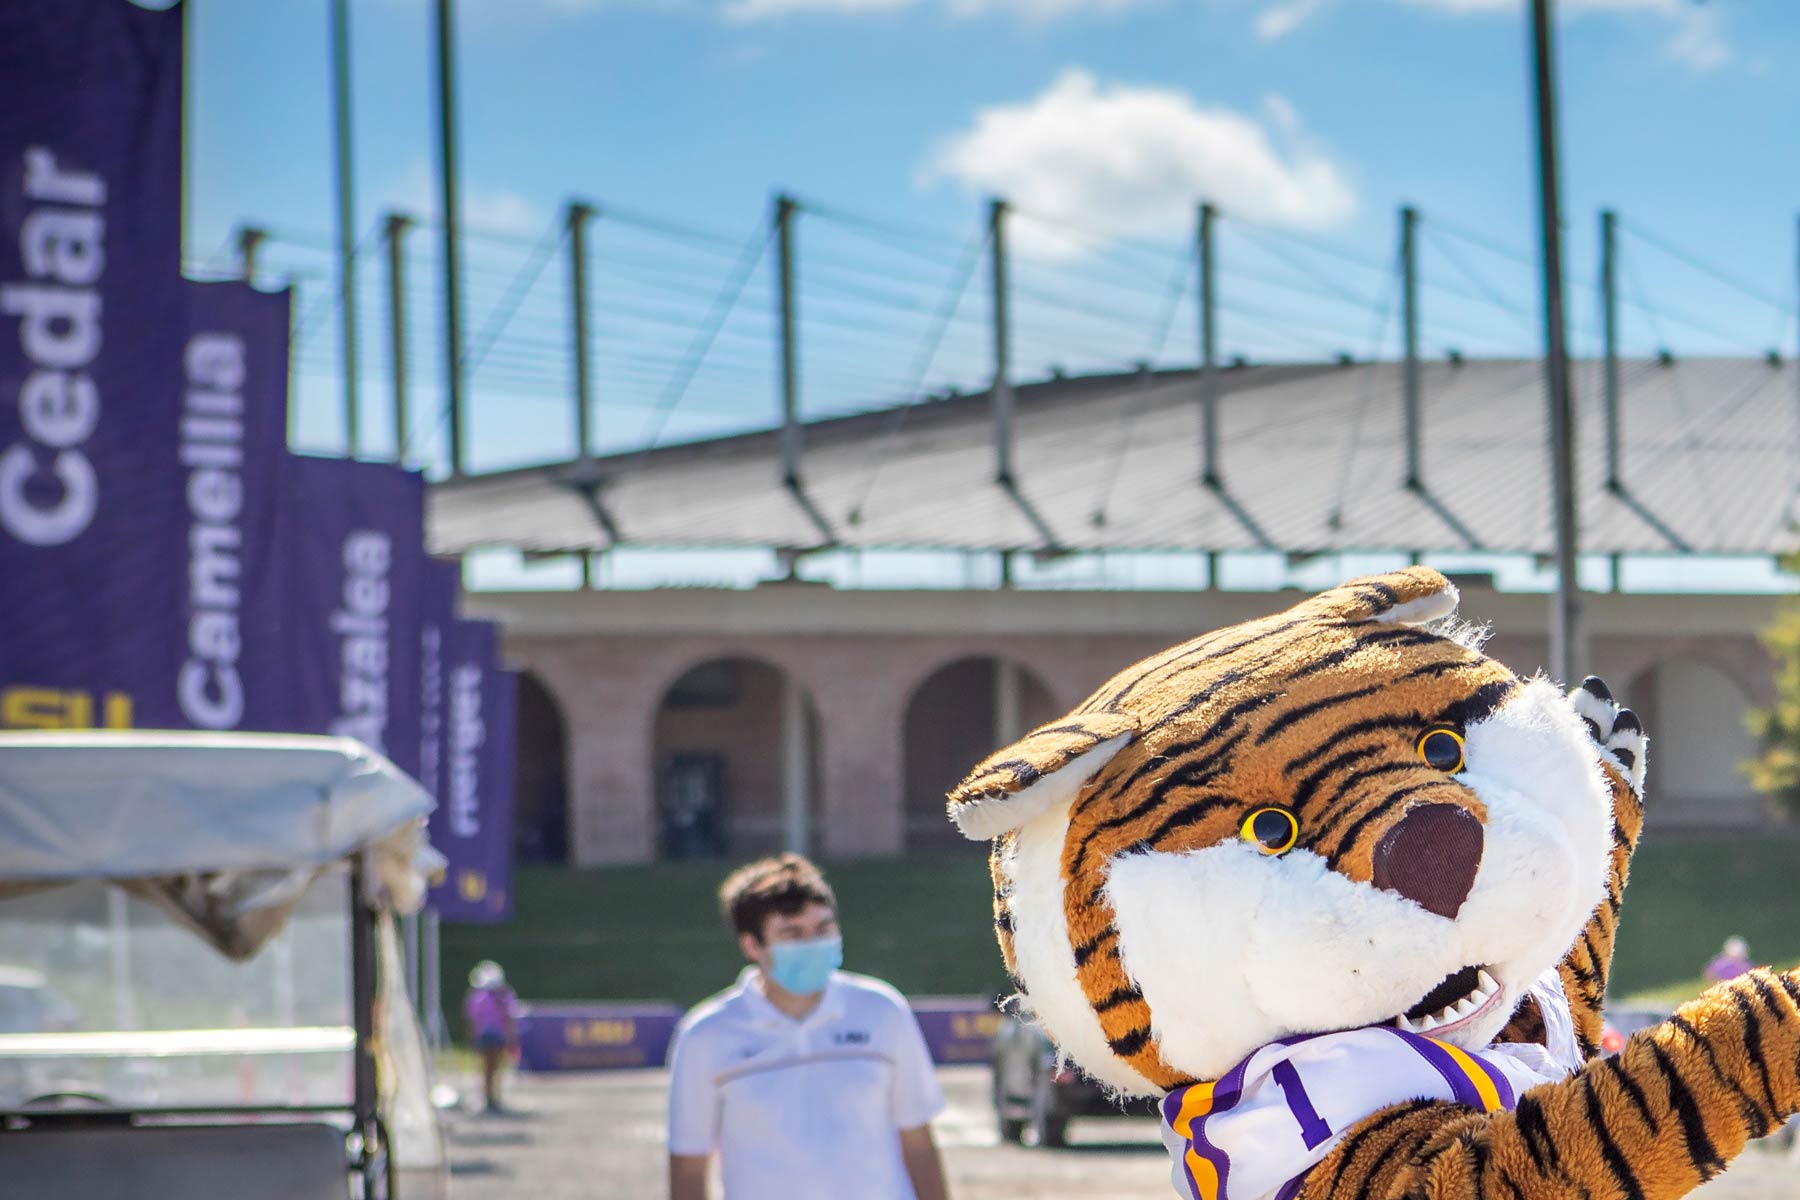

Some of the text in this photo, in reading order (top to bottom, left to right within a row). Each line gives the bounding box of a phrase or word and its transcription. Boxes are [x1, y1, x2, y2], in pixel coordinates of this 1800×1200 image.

[0, 146, 106, 546] Cedar
[177, 335, 245, 730] Camellia
[329, 530, 391, 754] Azalea
[1272, 1058, 1333, 1152] 1
